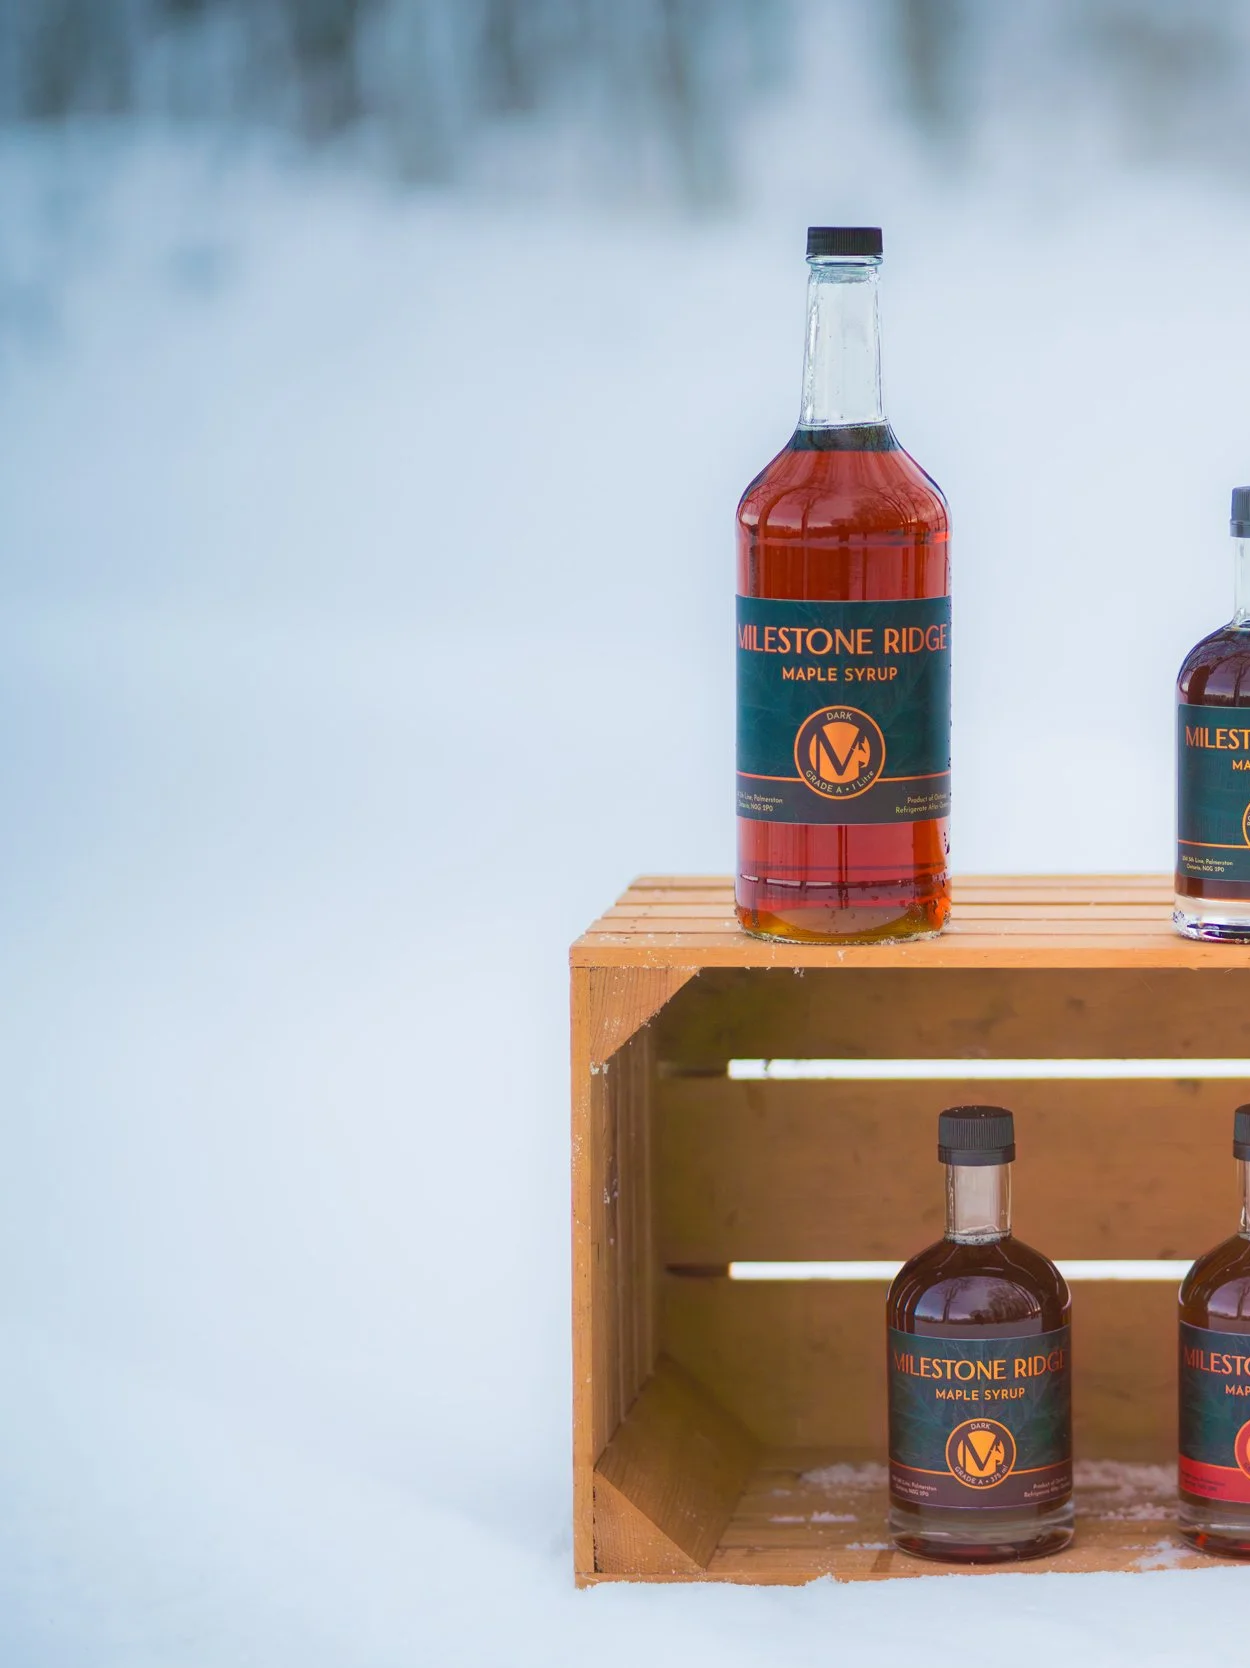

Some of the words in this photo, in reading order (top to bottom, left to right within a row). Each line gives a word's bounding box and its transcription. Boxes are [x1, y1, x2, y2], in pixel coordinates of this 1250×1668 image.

[738, 624, 874, 655] MILESTONE
[884, 624, 948, 654] RIDGE
[782, 666, 838, 682] MAPLE
[844, 667, 898, 682] SYRUP
[826, 711, 853, 721] DARK
[805, 770, 834, 793] GRADE
[836, 786, 842, 794] A
[857, 770, 874, 787] Litre
[894, 1351, 1007, 1381] MILESTONE
[936, 1388, 979, 1401] MAPLE
[984, 1387, 1026, 1400] SYRUP
[970, 1422, 991, 1430] DARK
[954, 1466, 977, 1484] GRADE
[990, 1473, 1001, 1482] 375
